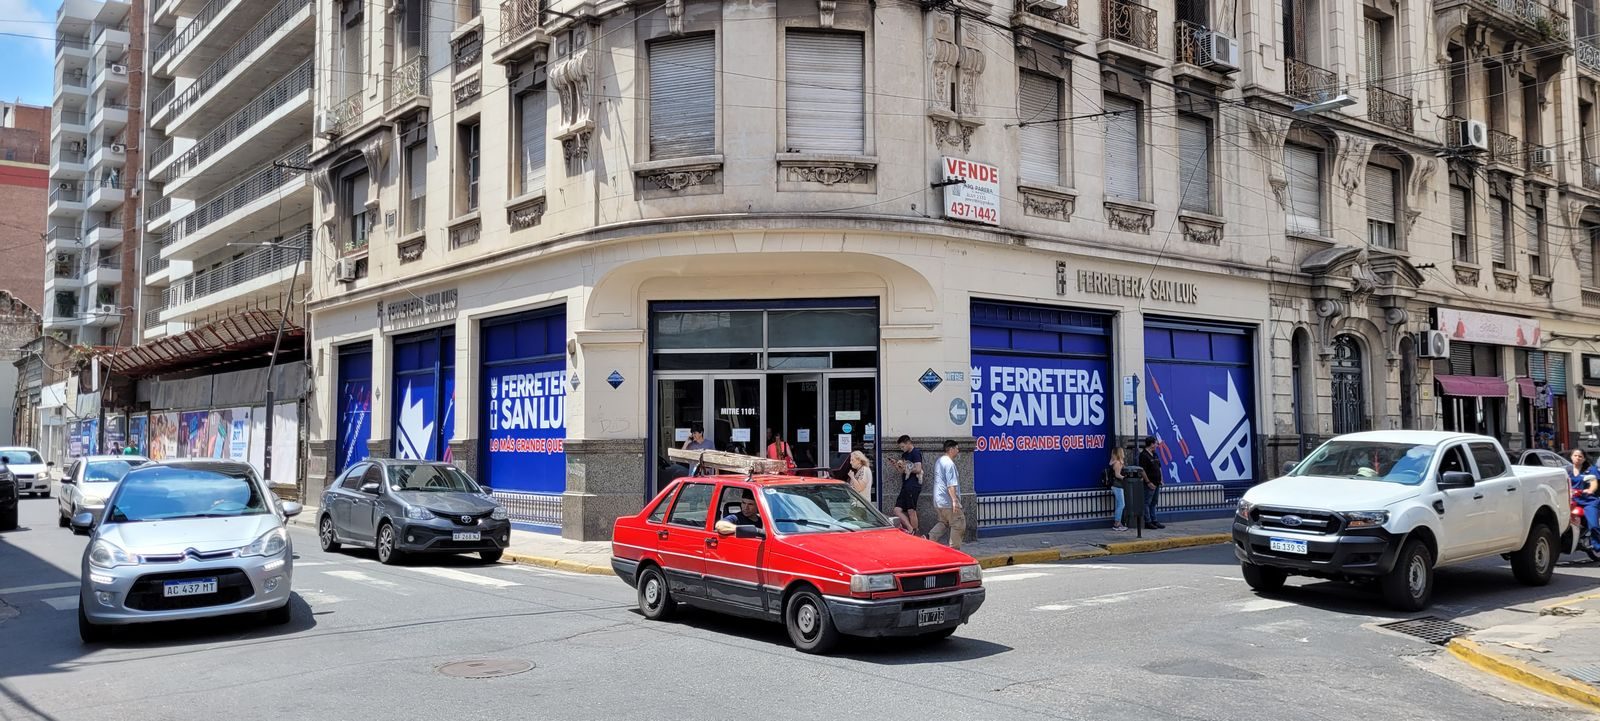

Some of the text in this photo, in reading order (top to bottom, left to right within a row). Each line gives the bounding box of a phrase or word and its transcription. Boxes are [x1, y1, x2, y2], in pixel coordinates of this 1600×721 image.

[946, 158, 998, 184] VENDE
[951, 201, 997, 222] 437-1442
[1077, 269, 1199, 304] FERRETERA SAN LUIS
[990, 366, 1104, 393] FERRETERA
[501, 397, 538, 430] SAN
[720, 407, 740, 416] MITRE
[990, 392, 1105, 426] SAN LUIS
[489, 435, 564, 455] LO MÁS GRANDE QUE
[989, 432, 1014, 450] MÁS
[1016, 435, 1062, 450] GRANDE
[1062, 435, 1083, 452] QUE
[1085, 434, 1106, 449] HAY
[1272, 542, 1306, 553] AG 139 SS
[167, 582, 215, 595] AC 437 MT
